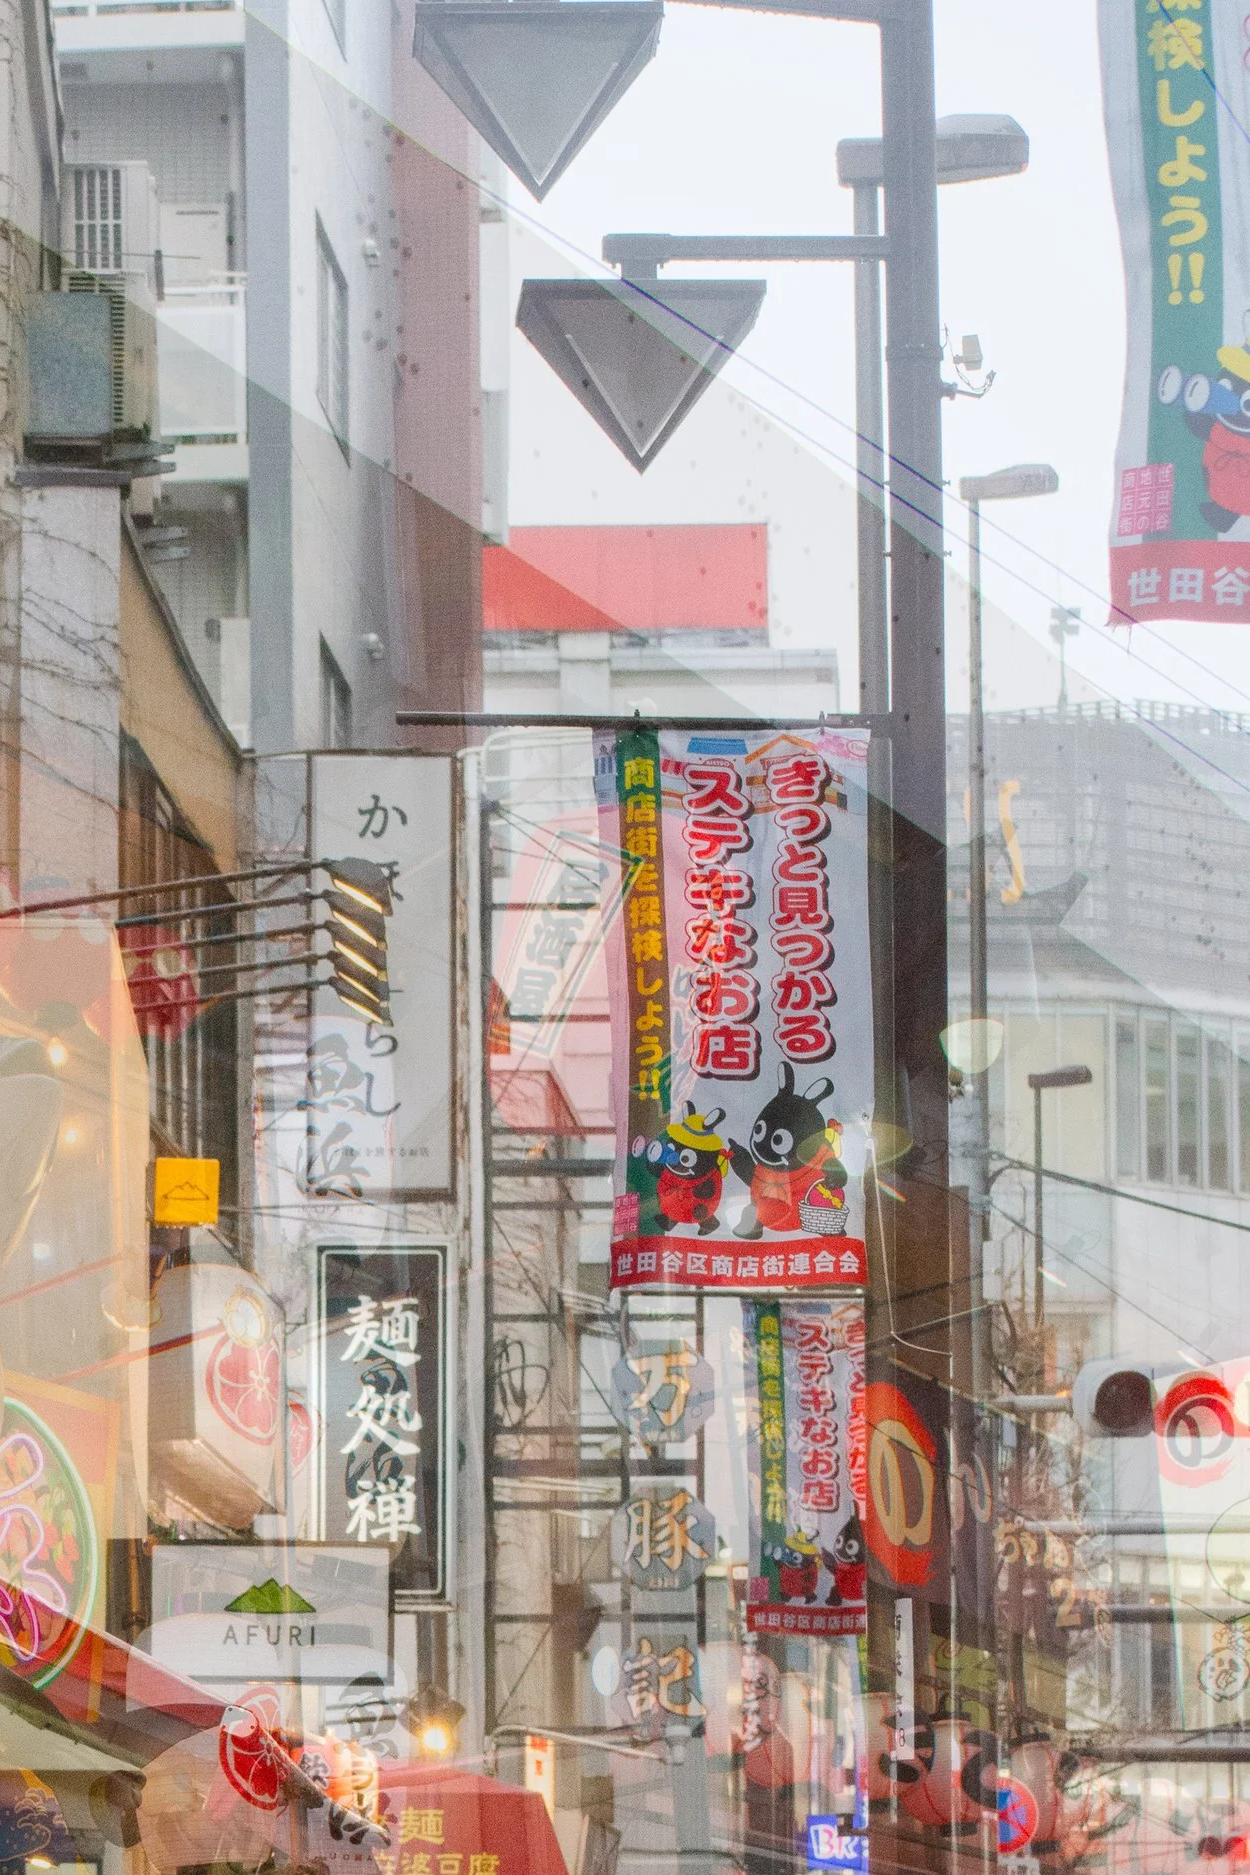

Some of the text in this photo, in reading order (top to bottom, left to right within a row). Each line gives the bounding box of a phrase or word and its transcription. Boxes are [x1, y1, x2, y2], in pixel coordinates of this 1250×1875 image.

[1146, 0, 1209, 305] 検しよう!!
[1128, 566, 1249, 606] 世田谷
[686, 766, 756, 1074] ステキなお店
[768, 754, 834, 1062] きっと見つかる
[617, 1251, 861, 1277] 世田谷区商店街連合会
[798, 1322, 837, 1511] ステキなお店
[223, 1625, 316, 1647] AFURI
